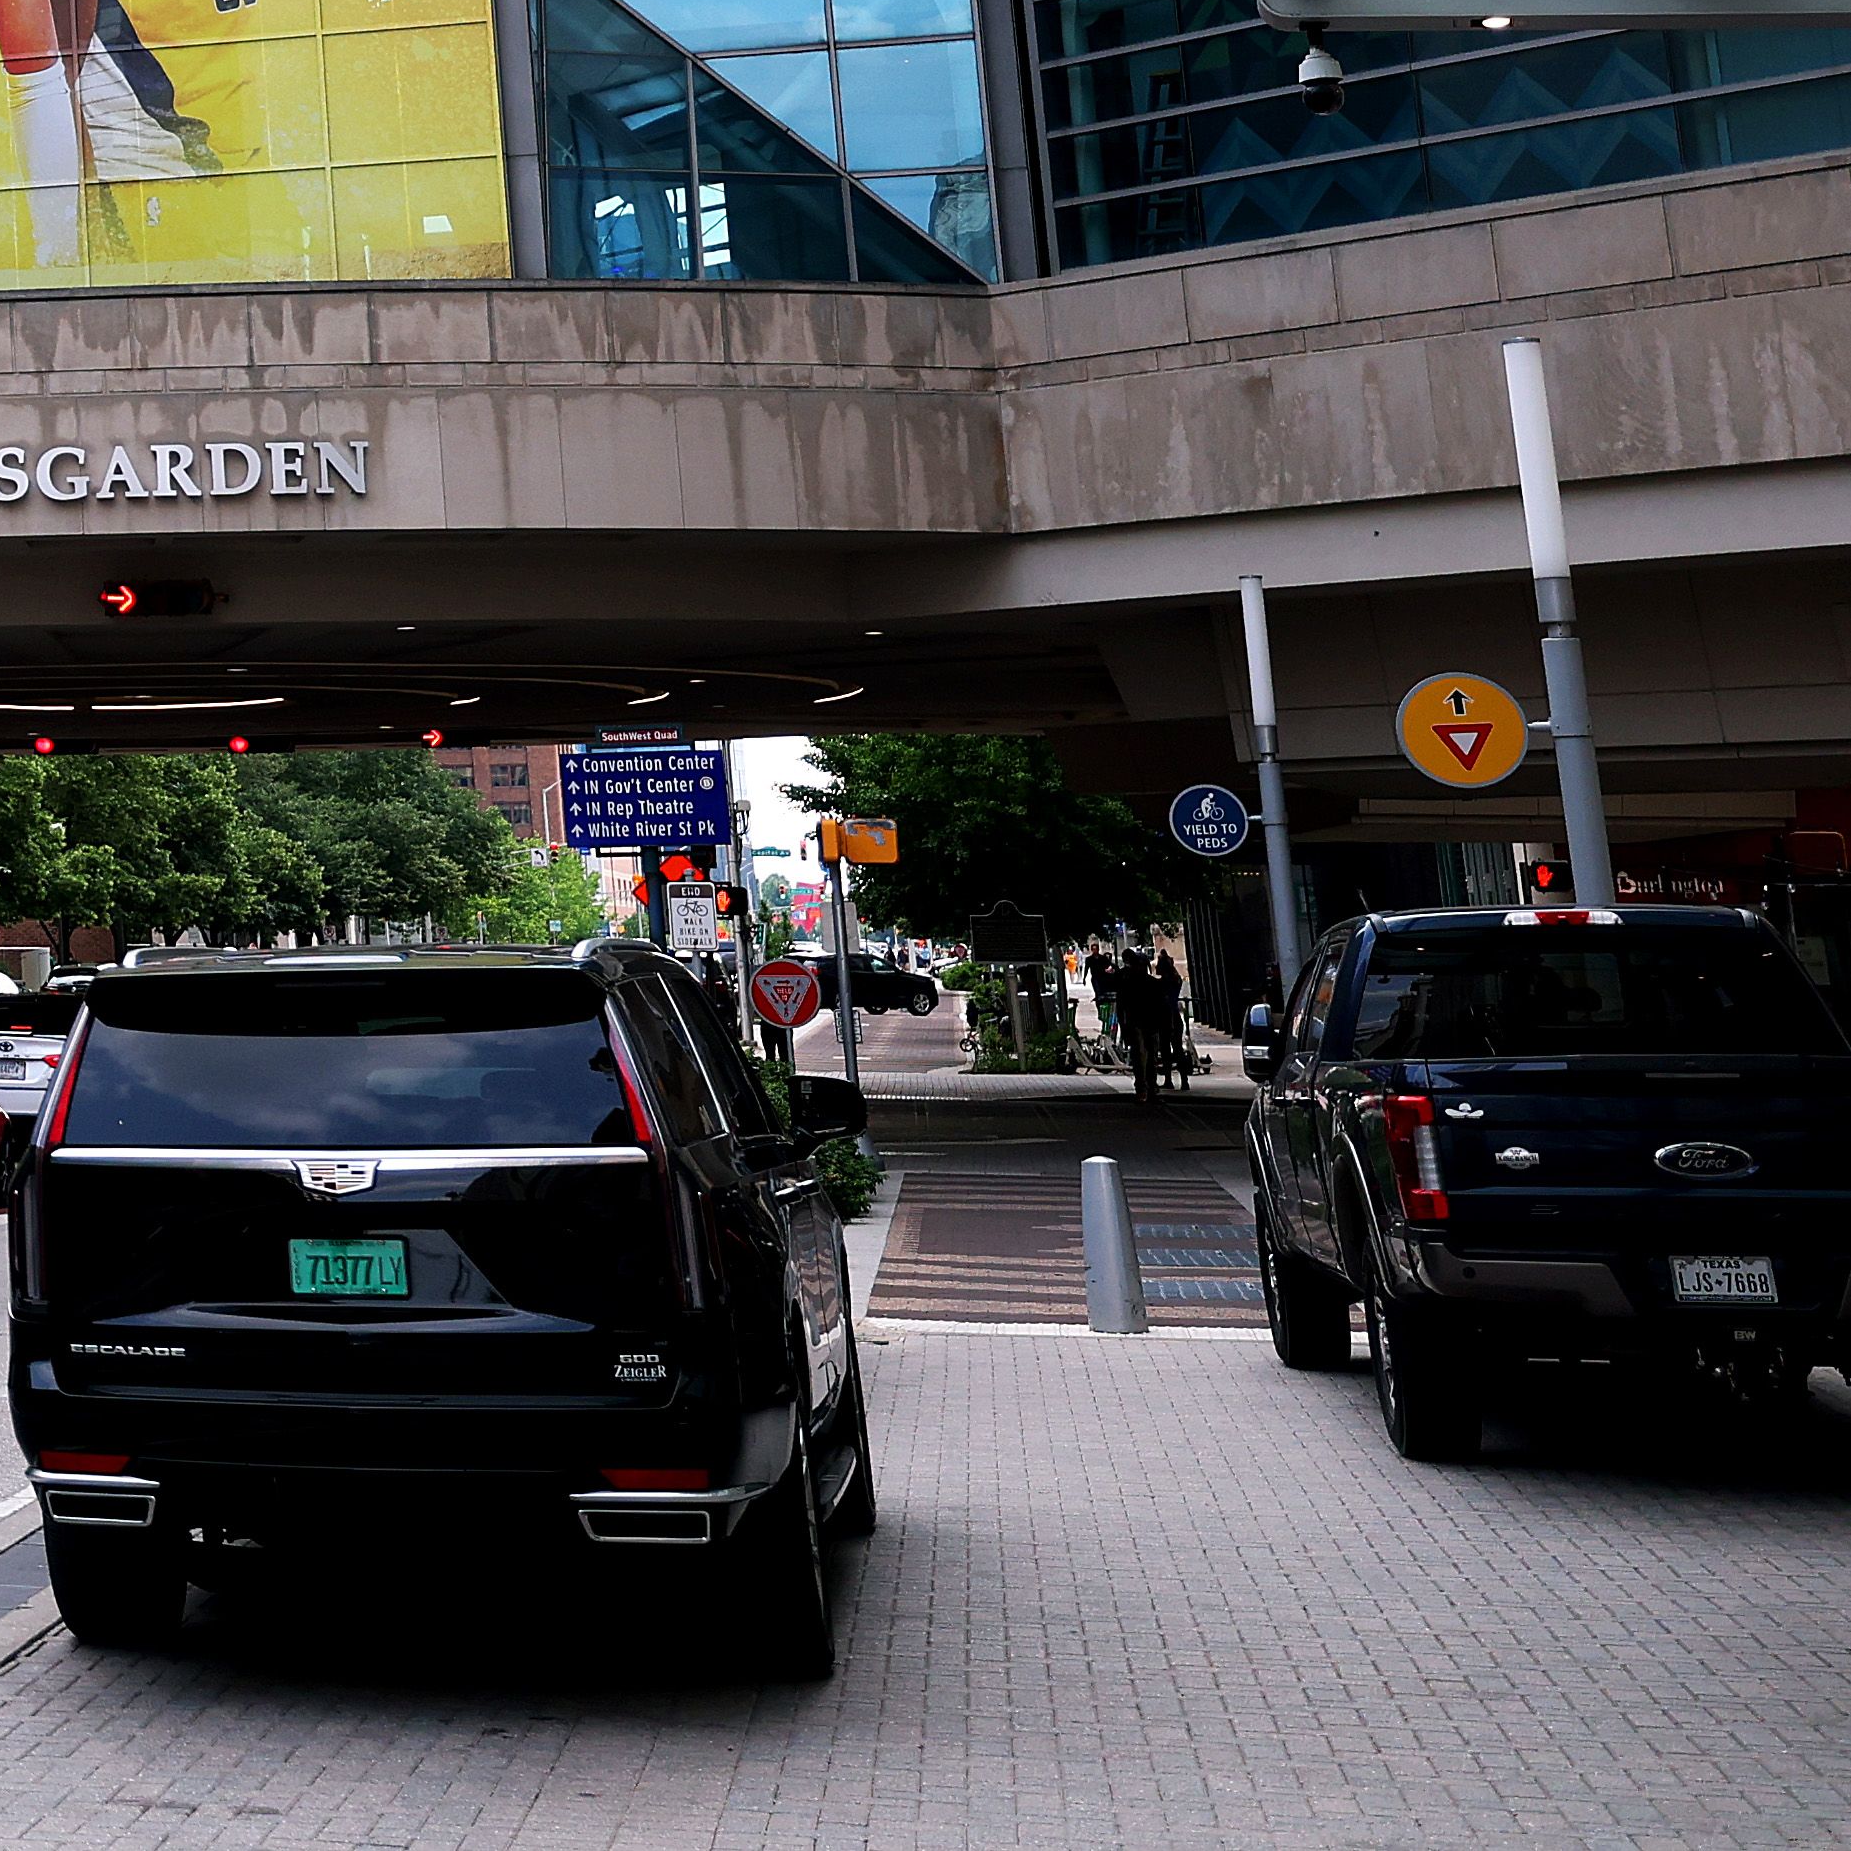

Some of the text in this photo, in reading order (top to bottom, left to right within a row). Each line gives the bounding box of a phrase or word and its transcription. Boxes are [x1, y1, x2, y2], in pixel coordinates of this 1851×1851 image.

[601, 730, 678, 742] SouthWest Quad
[582, 755, 715, 773] Convention Center
[584, 780, 599, 795] IN
[605, 778, 642, 794] Gov't
[647, 778, 694, 793] Center
[586, 799, 694, 819] IN Rep Theatre
[588, 820, 715, 838] White River St Pk
[1183, 823, 1237, 836] YIELD TO
[1197, 837, 1228, 849] PEDS
[681, 887, 701, 896] END
[1617, 871, 1724, 900] Burlngton
[684, 918, 703, 926] WALK
[679, 928, 696, 936] BIKE
[677, 937, 713, 946] SIDEALK
[1678, 1149, 1730, 1169] Ford
[306, 1254, 374, 1285] 71377
[1701, 1259, 1741, 1269] TEXAS
[69, 1343, 186, 1357] ESCALADE
[619, 1354, 660, 1363] 600
[613, 1364, 667, 1378] ZEIGLER
